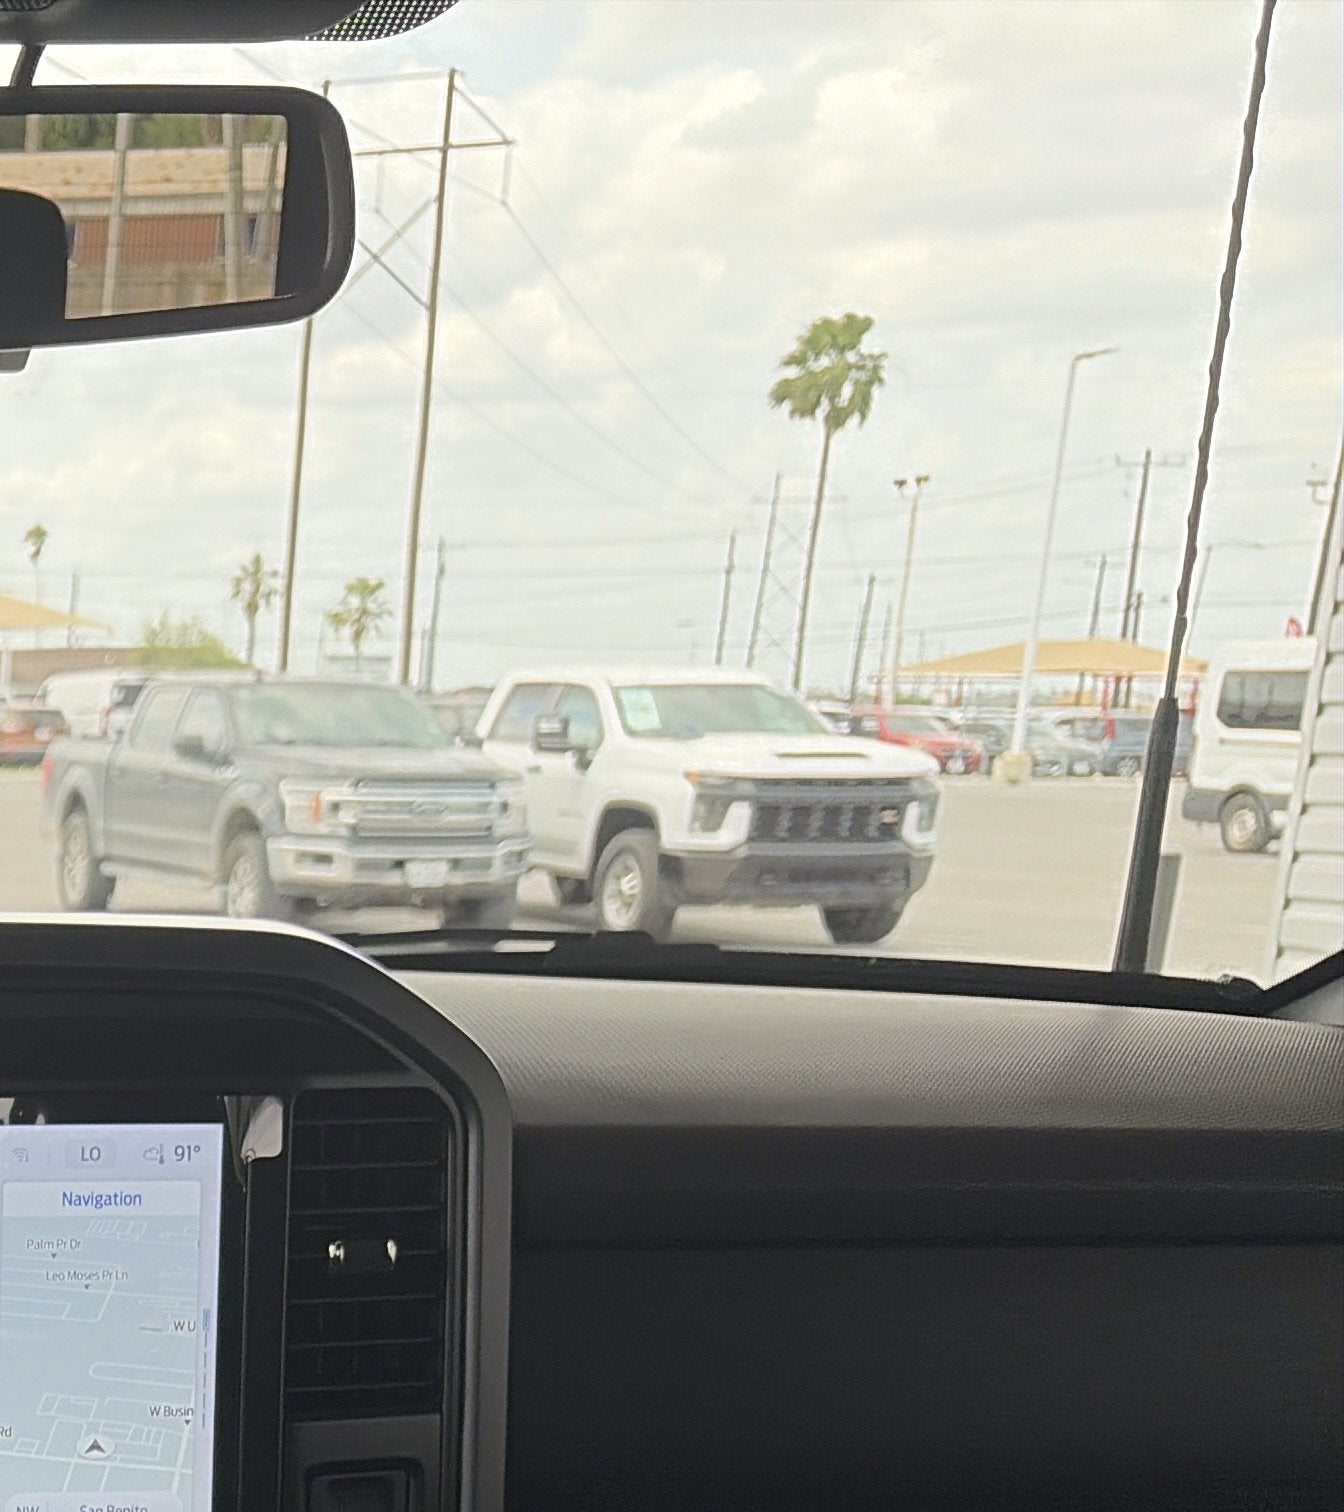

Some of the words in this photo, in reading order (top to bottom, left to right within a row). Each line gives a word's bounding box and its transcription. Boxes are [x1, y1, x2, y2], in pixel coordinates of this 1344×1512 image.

[80, 1146, 101, 1162] LO
[174, 1145, 201, 1162] 91°
[61, 1191, 142, 1209] Navigation
[26, 1239, 54, 1250] Palm
[56, 1239, 68, 1250] Pr
[69, 1239, 81, 1249] Dr
[45, 1271, 65, 1281] Leo
[67, 1271, 100, 1281] Moses
[101, 1270, 113, 1281] Pr
[115, 1270, 128, 1280] Ln
[149, 1406, 161, 1417] W
[163, 1405, 194, 1417] Busin
